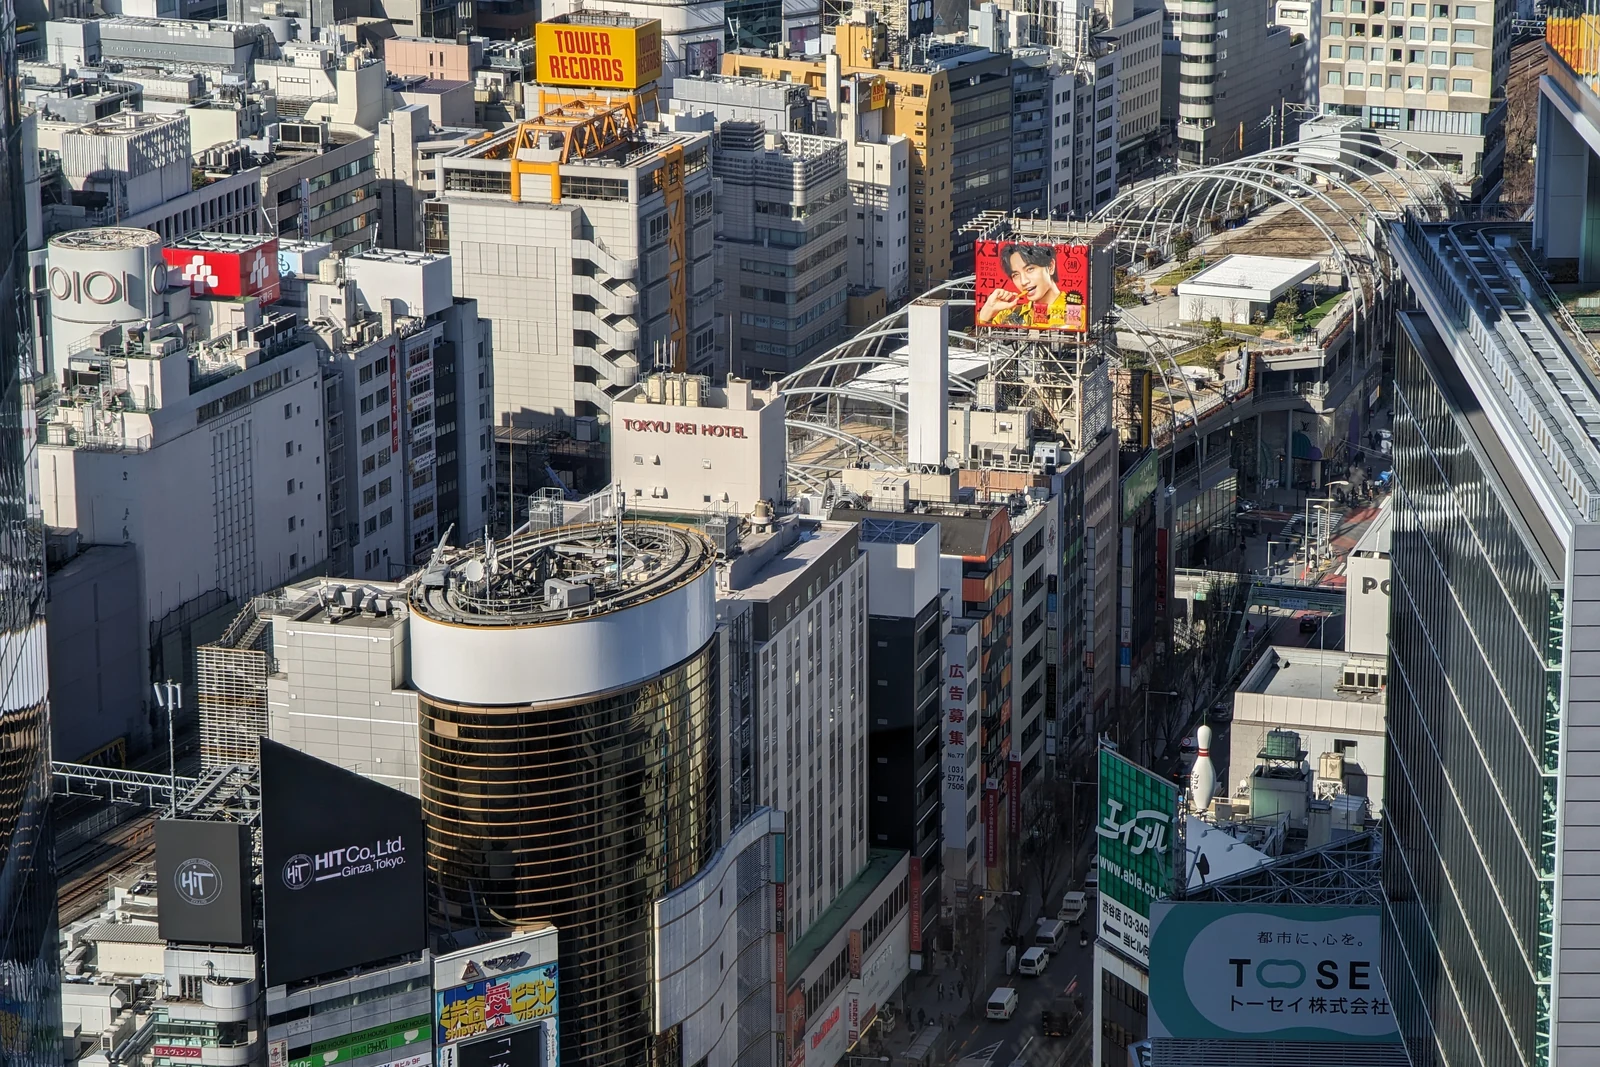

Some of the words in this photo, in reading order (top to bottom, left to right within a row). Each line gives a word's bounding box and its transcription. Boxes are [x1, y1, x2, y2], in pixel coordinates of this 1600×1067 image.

[554, 30, 611, 56] TOWER
[638, 32, 657, 56] TOWER
[549, 55, 624, 82] RECORDS
[638, 50, 660, 76] RECORDS
[788, 87, 806, 98] FPG
[872, 84, 885, 95] ABC
[980, 278, 1008, 289] スコーン
[1061, 279, 1083, 288] スコーン
[622, 418, 671, 434] TOKYU
[675, 422, 698, 435] REI
[701, 424, 748, 439] HOTEL
[948, 664, 965, 746] 広告募集
[947, 766, 964, 774] (03)
[947, 774, 965, 782] 5774
[947, 782, 965, 790] 7506
[1095, 798, 1170, 855] エイブル
[315, 848, 346, 871] HIT
[342, 863, 374, 877] Ginza,
[374, 856, 406, 870] Tokyo.
[1102, 898, 1122, 921] 渋谷店
[1257, 931, 1364, 947] 都市に、心を。
[1231, 994, 1390, 1015] トーセイ株式会社
[394, 1022, 408, 1031] PITAT
[410, 1017, 429, 1027] HOUSE
[445, 1022, 488, 1040] SHIBUYA
[493, 1015, 505, 1028] AI
[515, 1005, 553, 1021] VISION
[328, 1038, 348, 1048] HOUSE
[352, 1033, 366, 1042] PITAT
[367, 1028, 387, 1038] HOUSE
[163, 1048, 199, 1057] スヴェンソン
